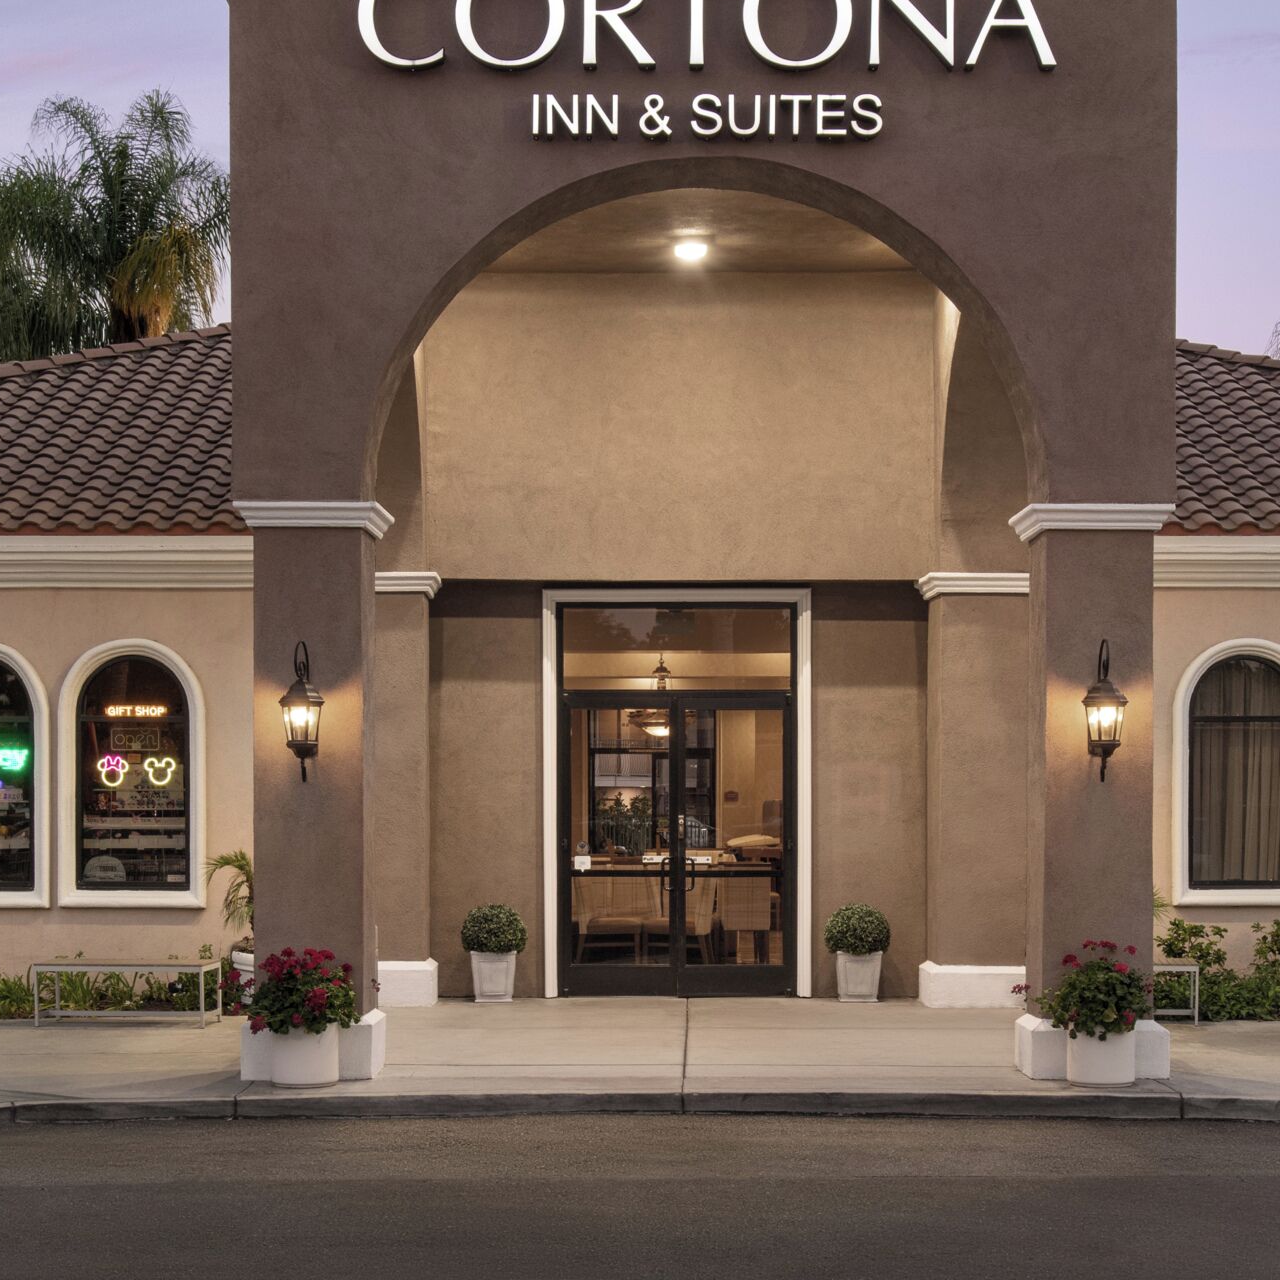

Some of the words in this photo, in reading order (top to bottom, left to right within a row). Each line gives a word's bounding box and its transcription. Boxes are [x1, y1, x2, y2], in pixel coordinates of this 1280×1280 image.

[532, 94, 620, 140] INN
[639, 94, 672, 140] &
[690, 94, 884, 140] SUITES
[107, 705, 132, 716] GIFT
[135, 705, 165, 716] SHOP
